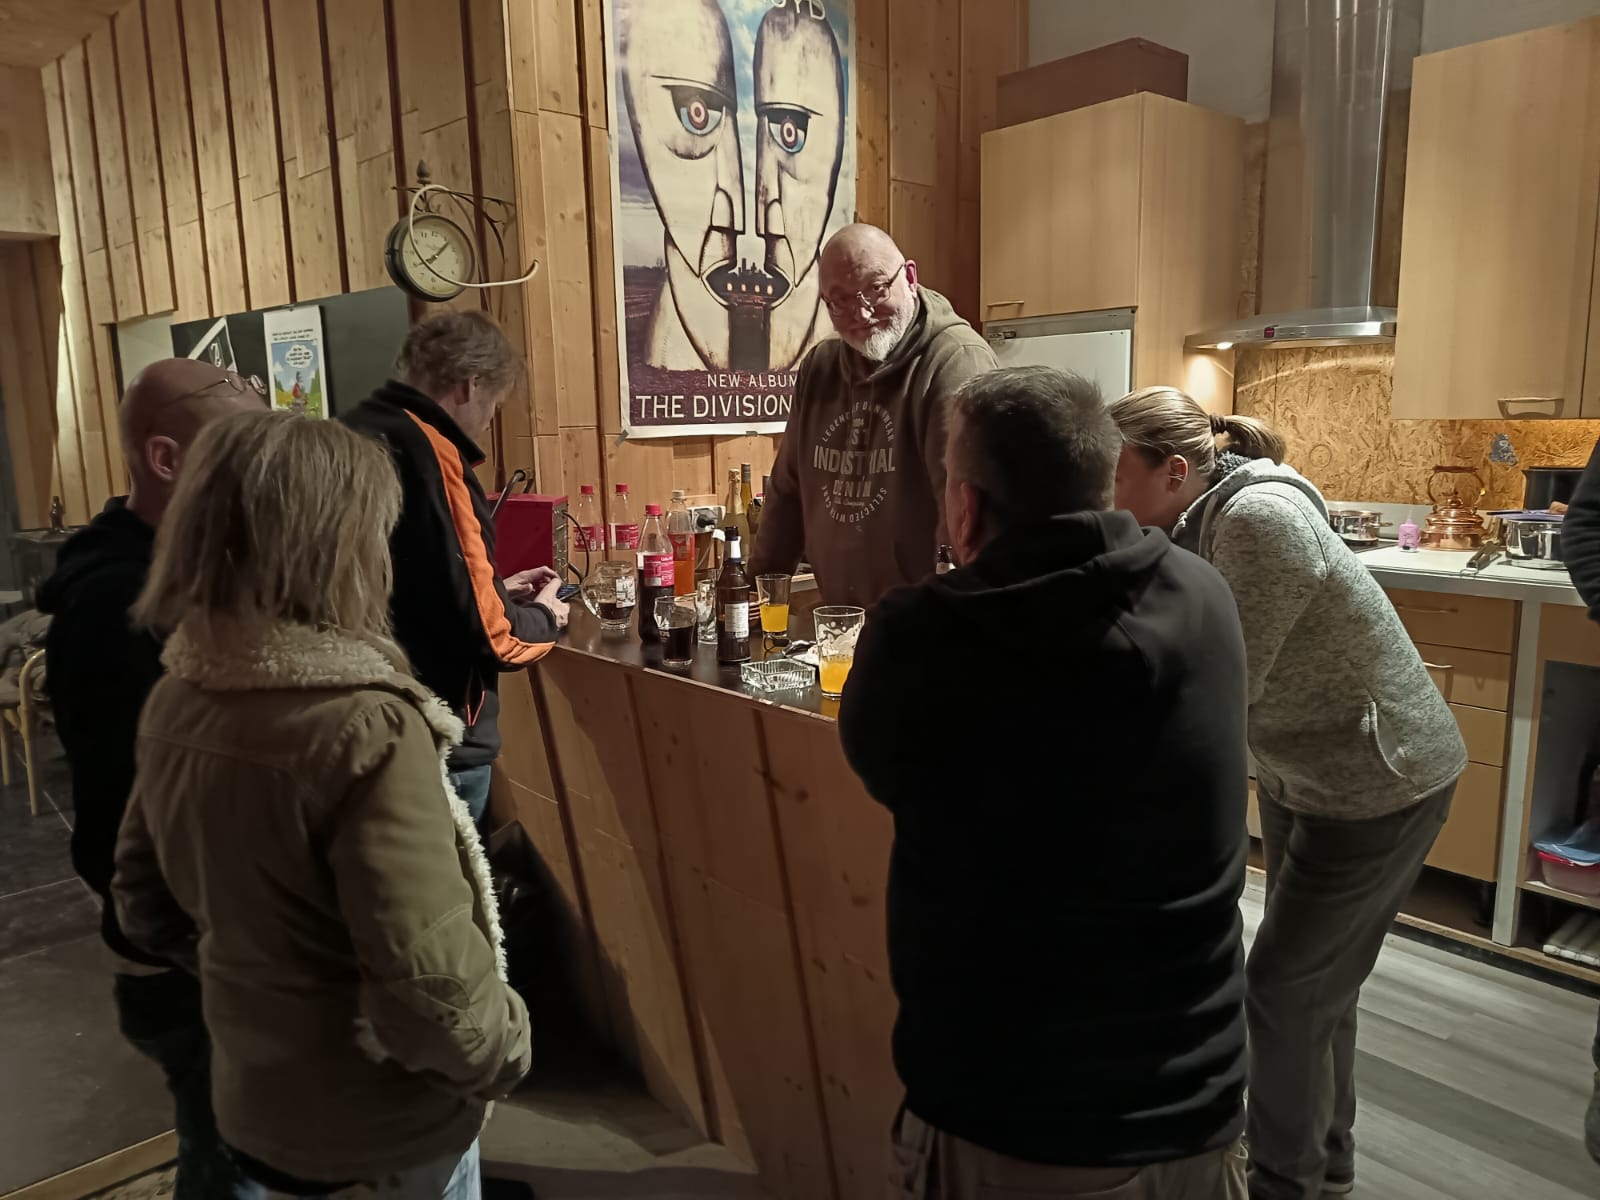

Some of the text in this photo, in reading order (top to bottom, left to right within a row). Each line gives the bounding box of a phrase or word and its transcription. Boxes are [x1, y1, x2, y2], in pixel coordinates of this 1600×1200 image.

[707, 373, 798, 388] NEW ALBUM
[636, 394, 793, 419] THE DIVISION
